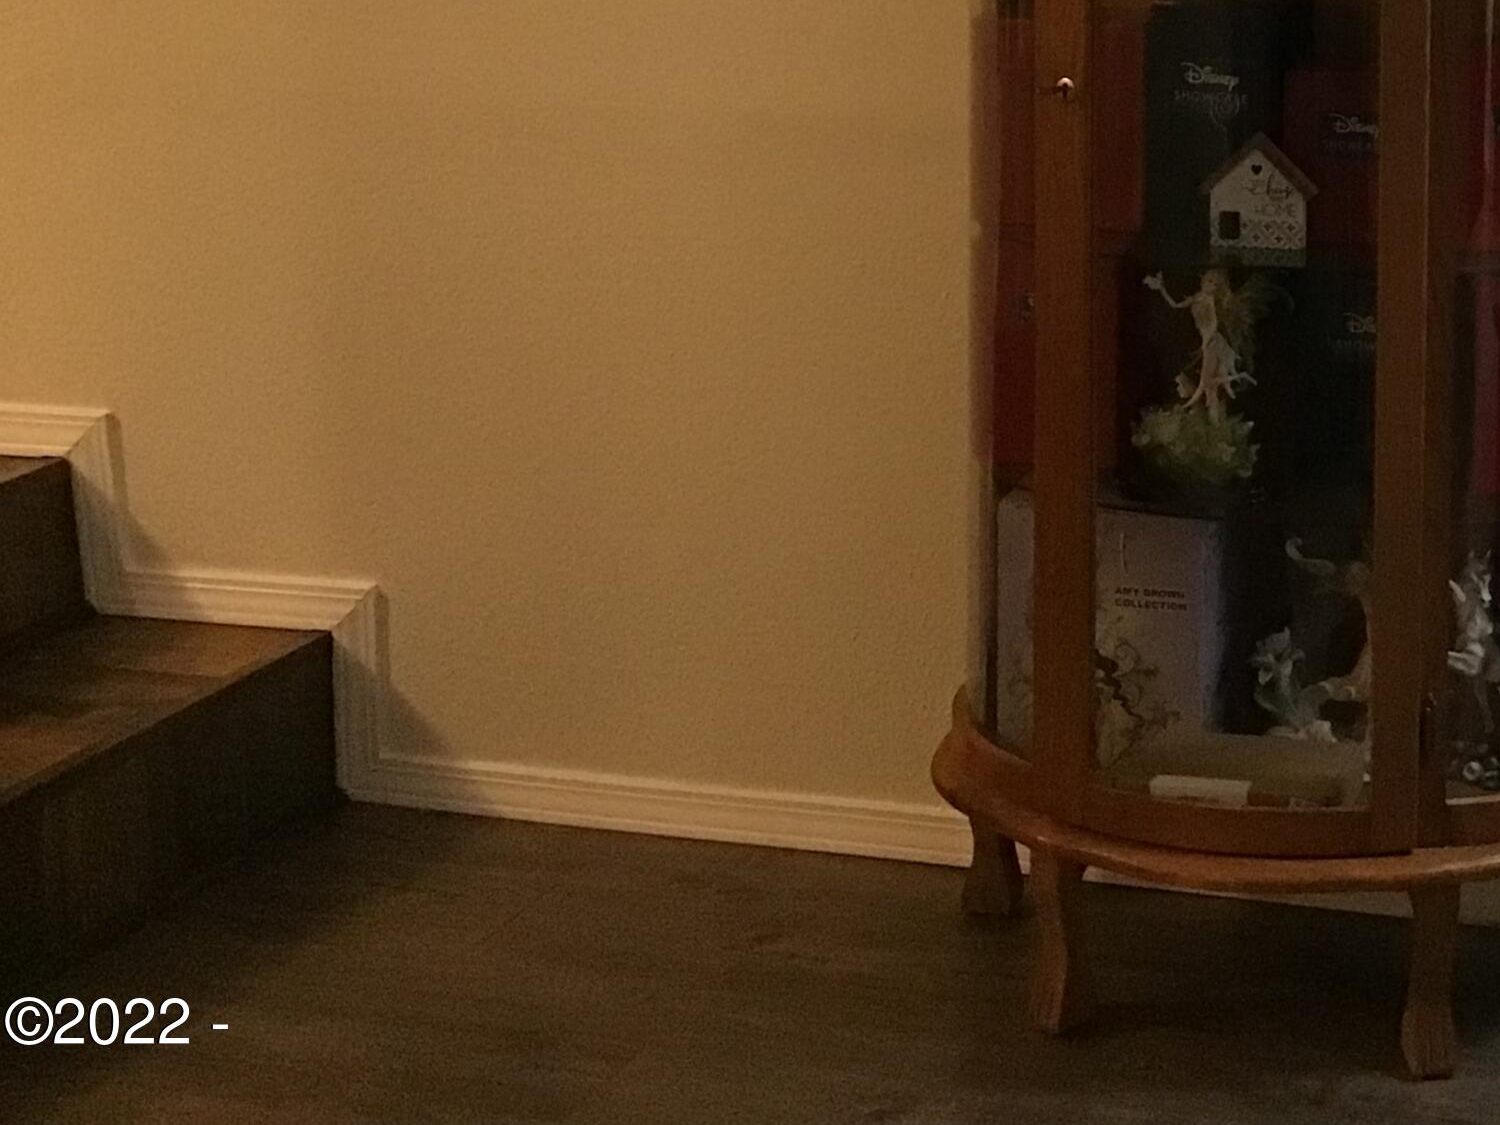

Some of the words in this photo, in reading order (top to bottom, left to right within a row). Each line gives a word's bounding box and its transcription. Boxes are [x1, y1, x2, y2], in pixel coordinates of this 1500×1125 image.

[1180, 61, 1240, 92] Disney
[1343, 312, 1377, 334] Dis
[1114, 598, 1188, 611] COLLECTION
